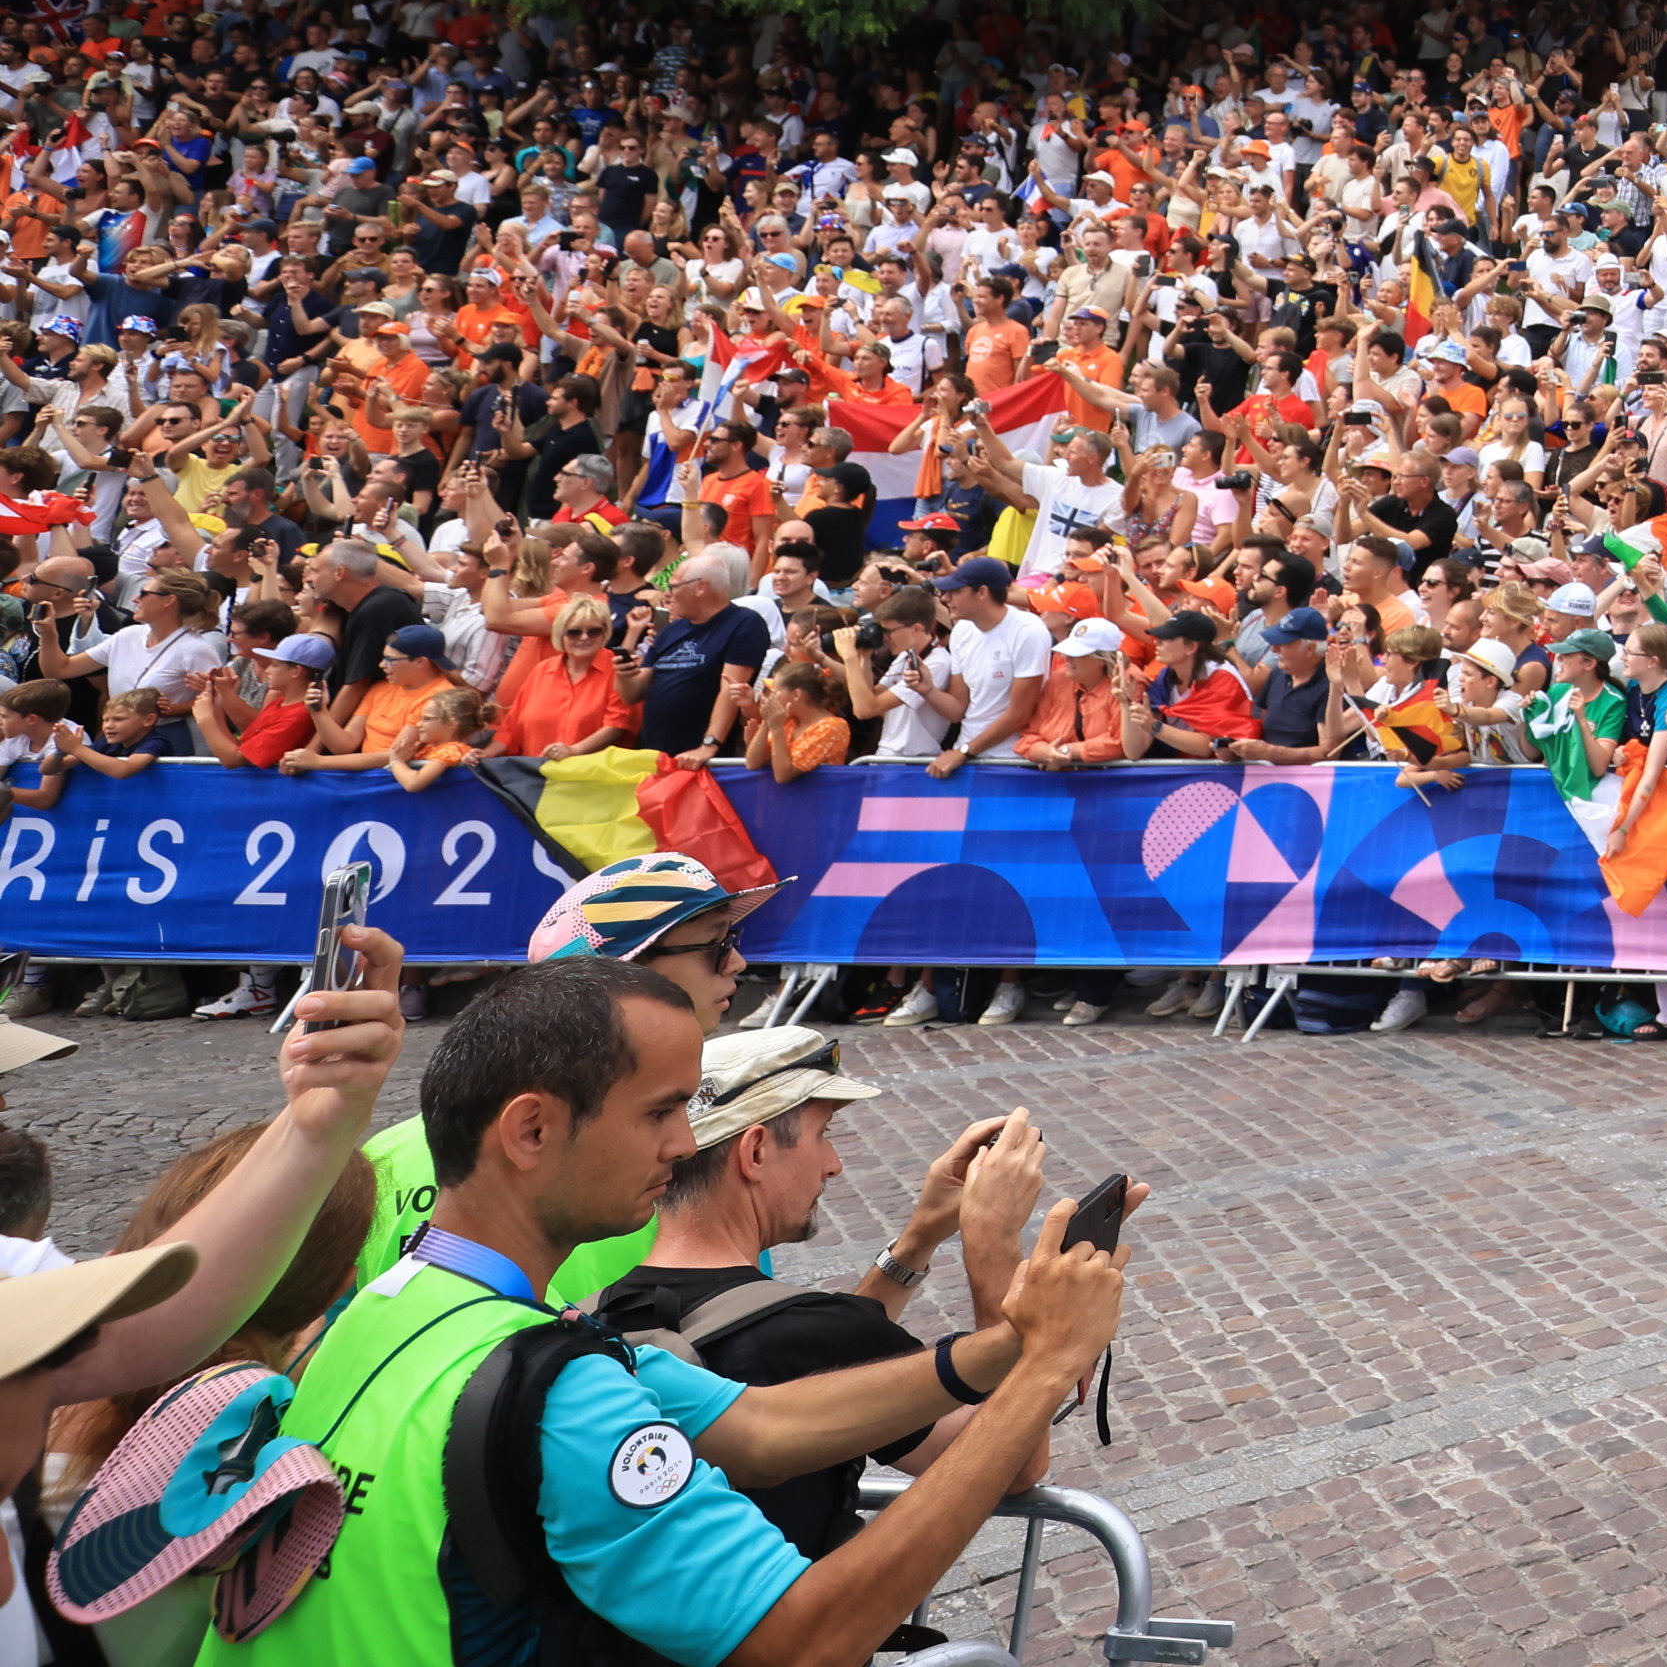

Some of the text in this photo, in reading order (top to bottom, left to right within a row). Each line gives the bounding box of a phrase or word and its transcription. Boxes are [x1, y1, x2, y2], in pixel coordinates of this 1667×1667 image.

[621, 1431, 669, 1476] VOLONTAIRE
[639, 1458, 683, 1496] PARIS 2024
